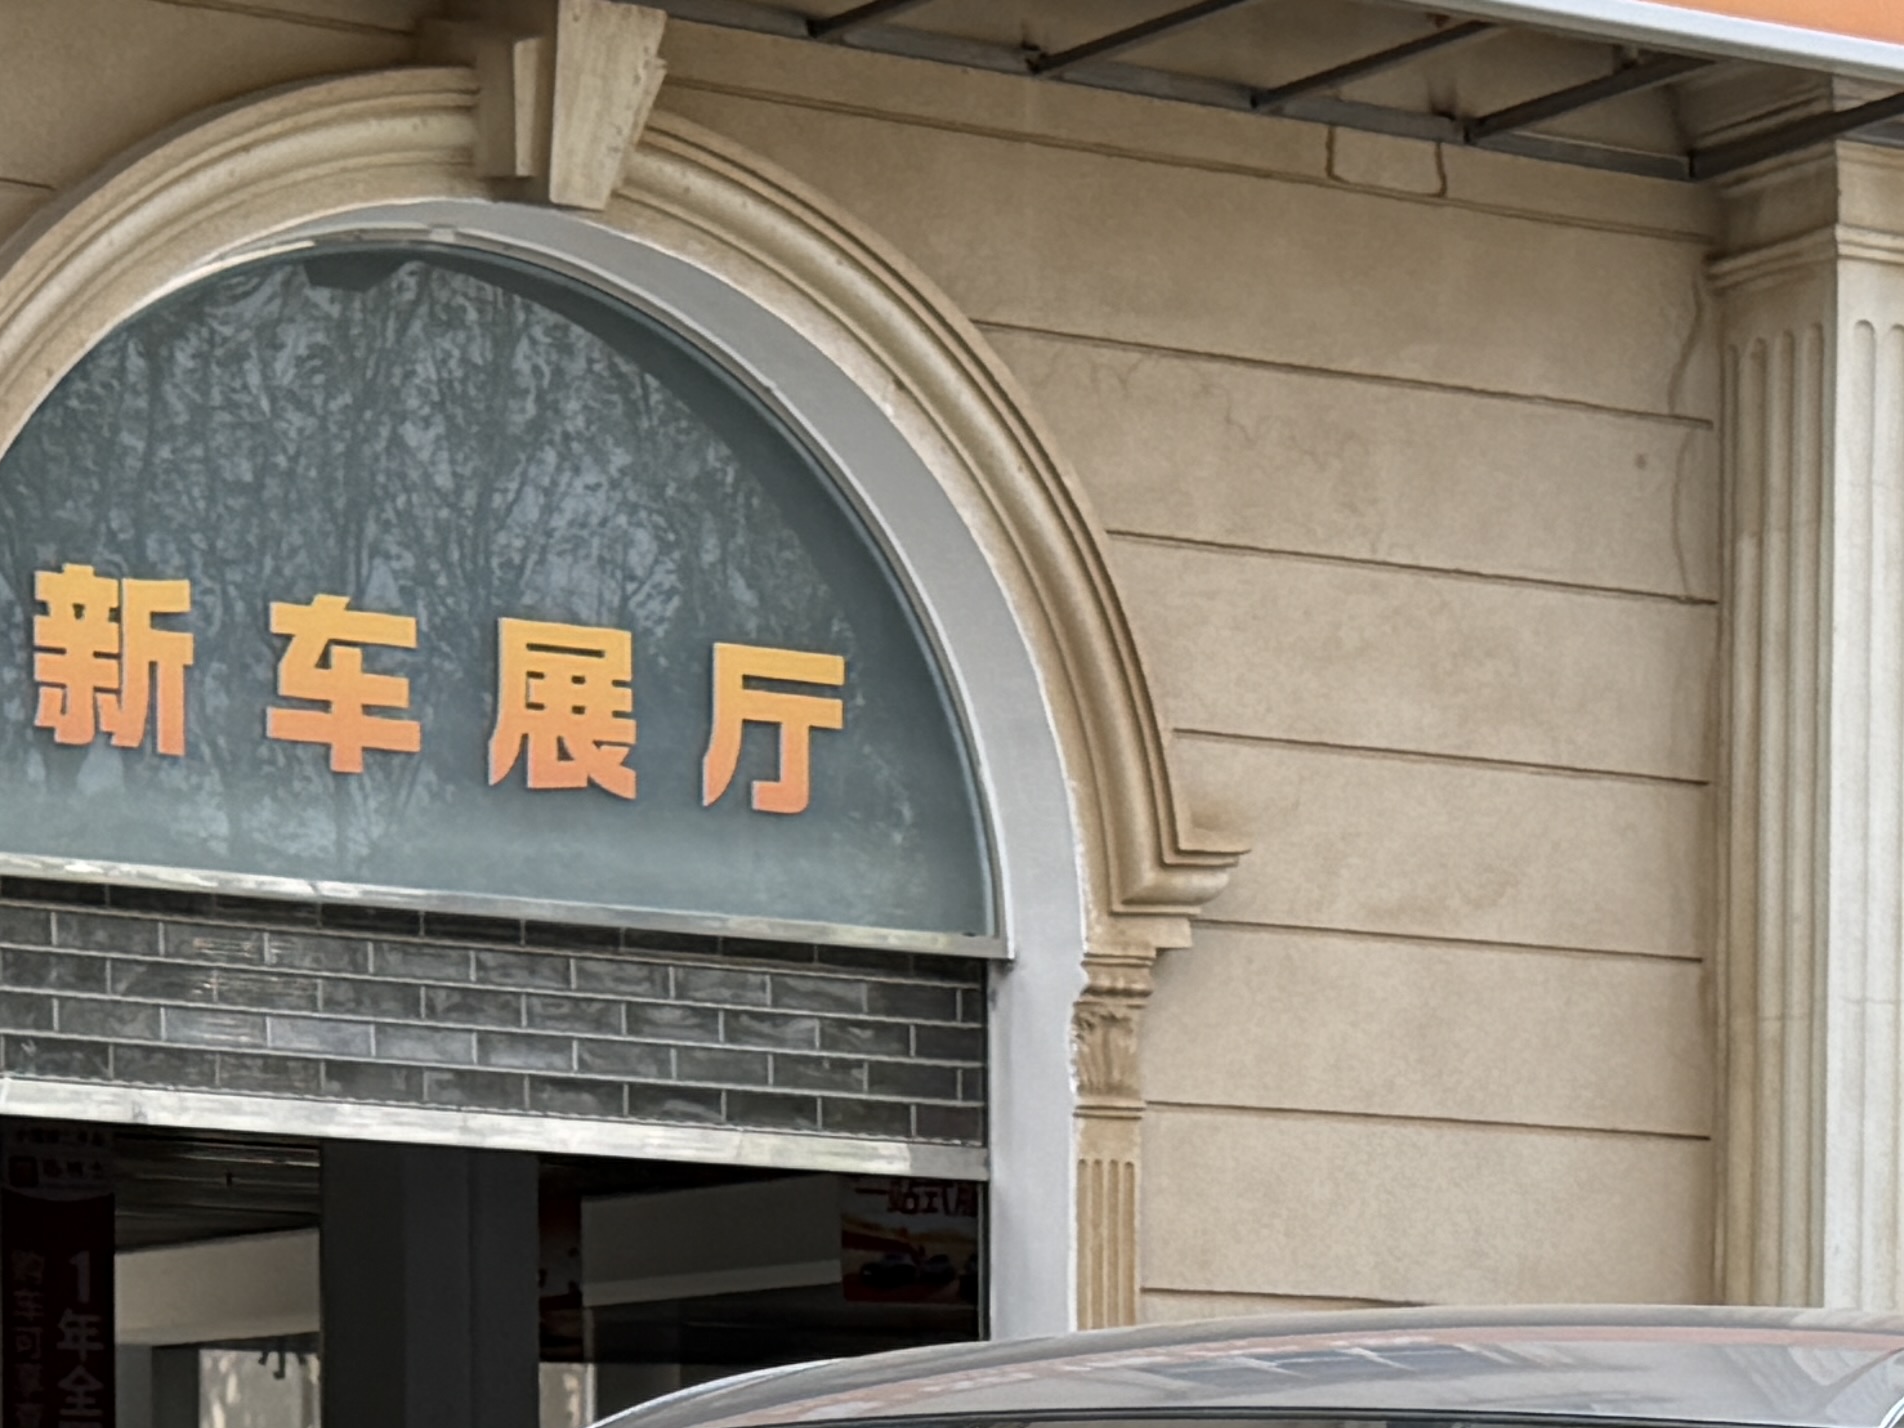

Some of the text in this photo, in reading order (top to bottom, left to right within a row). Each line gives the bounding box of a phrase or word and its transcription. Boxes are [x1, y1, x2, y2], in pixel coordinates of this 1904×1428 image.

[33, 562, 847, 815] 新车展厅
[854, 1177, 978, 1217] 一站式
